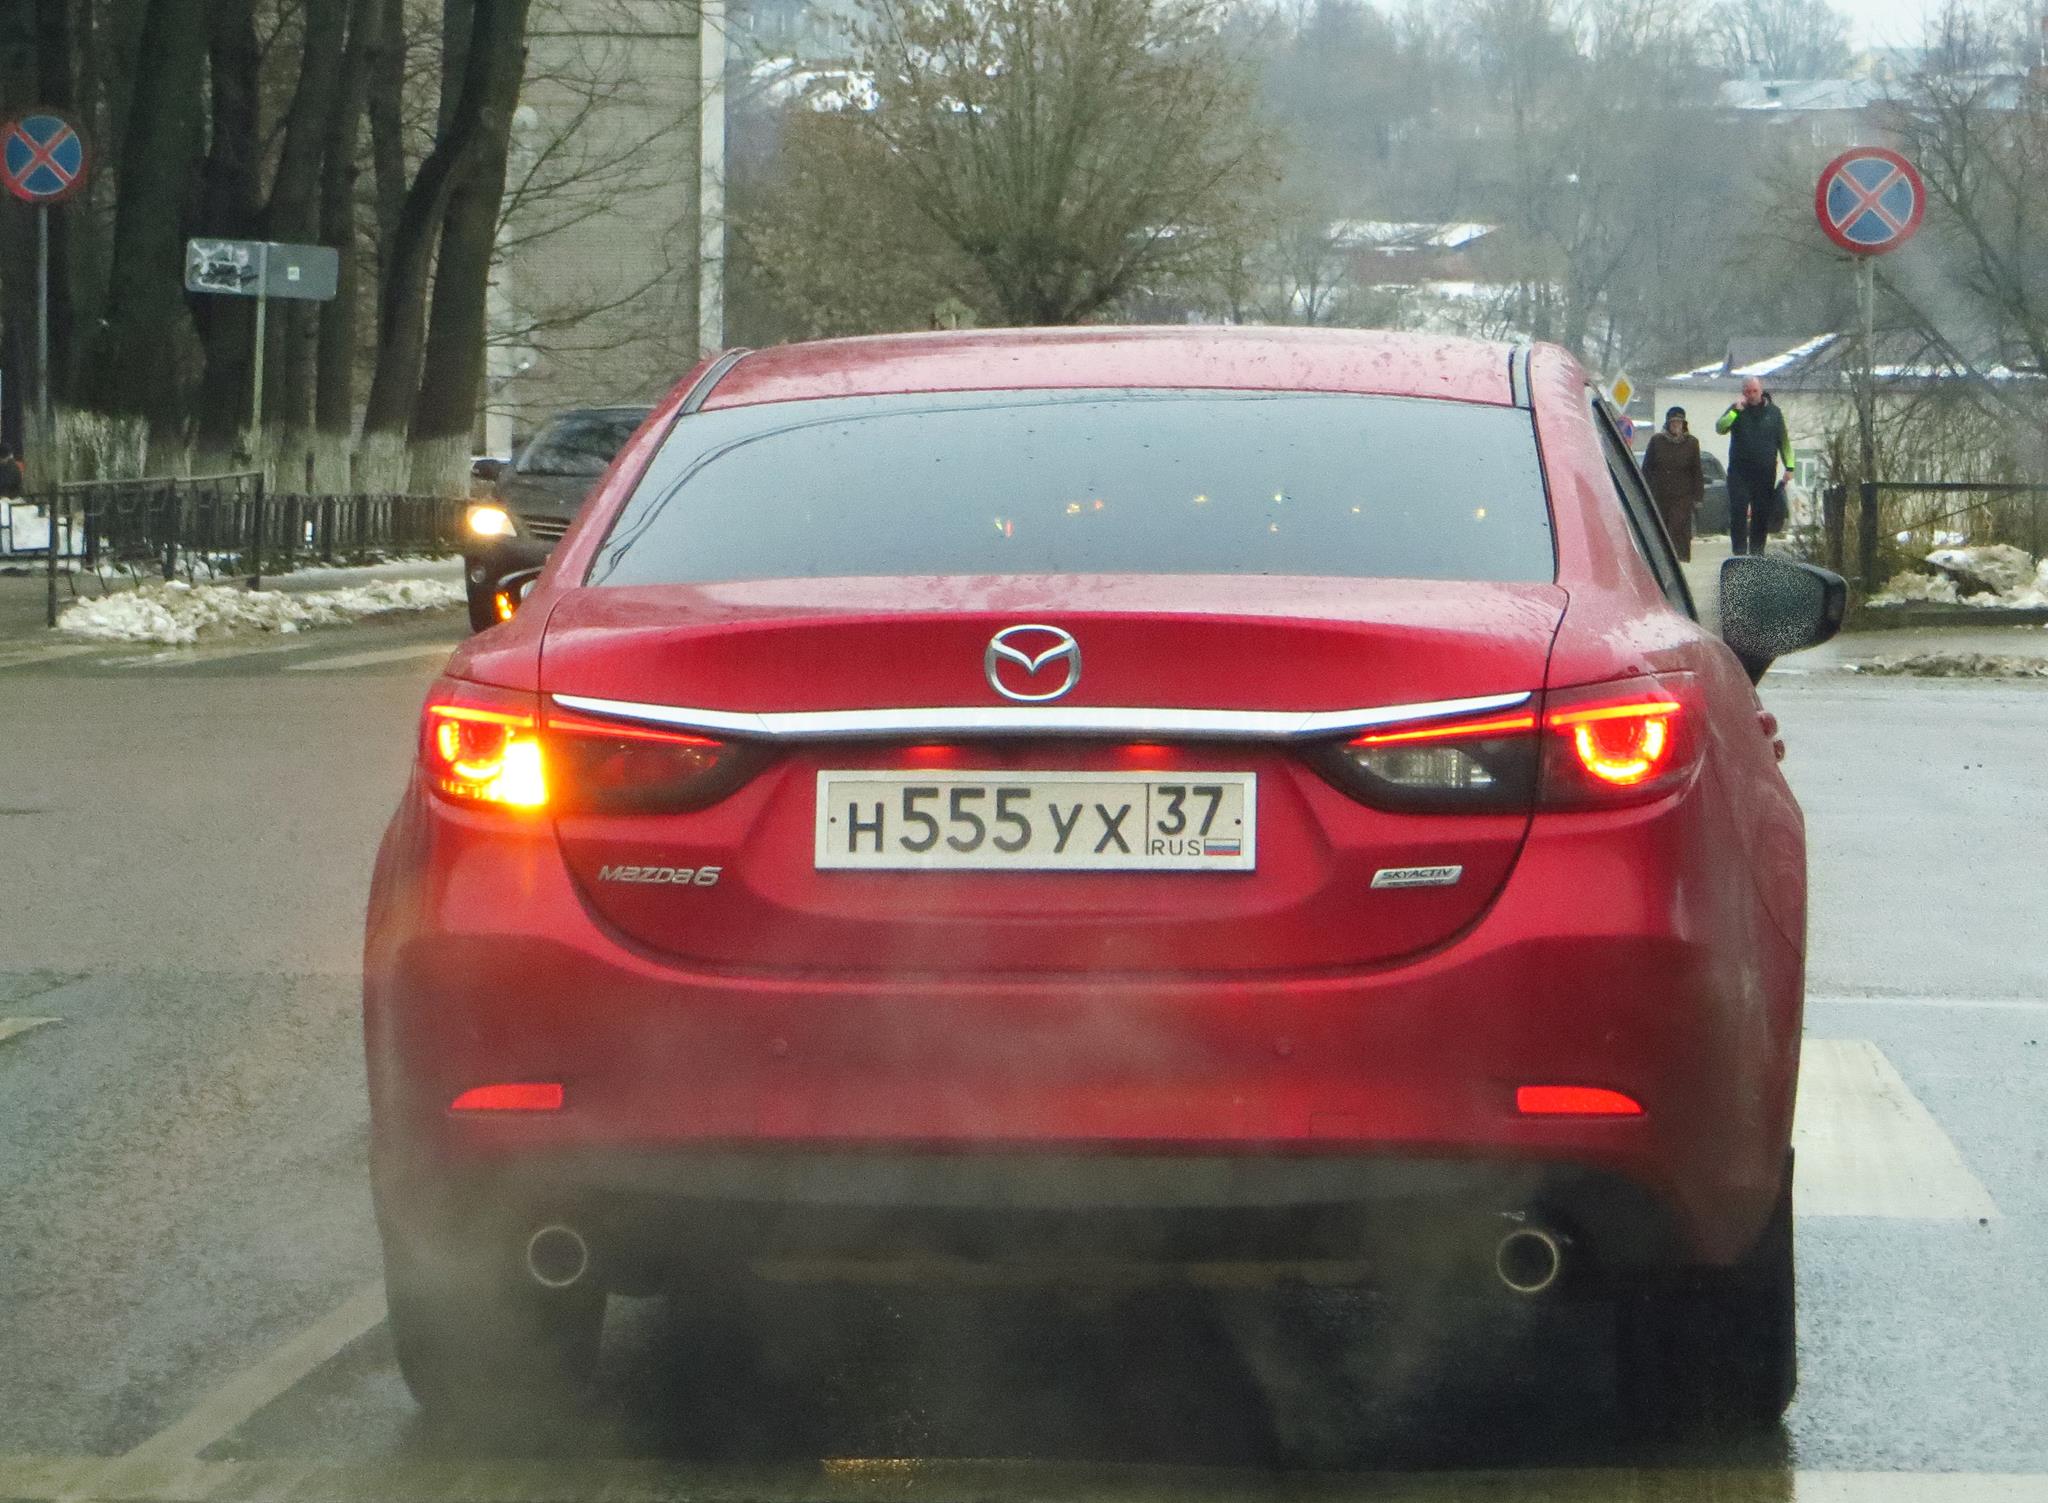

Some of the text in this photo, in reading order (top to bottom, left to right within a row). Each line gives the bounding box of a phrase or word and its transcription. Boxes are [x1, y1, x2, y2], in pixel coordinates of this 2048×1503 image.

[1156, 786, 1223, 836] 37
[1151, 839, 1200, 855] RUS
[1382, 868, 1452, 879] SKYACTIV
